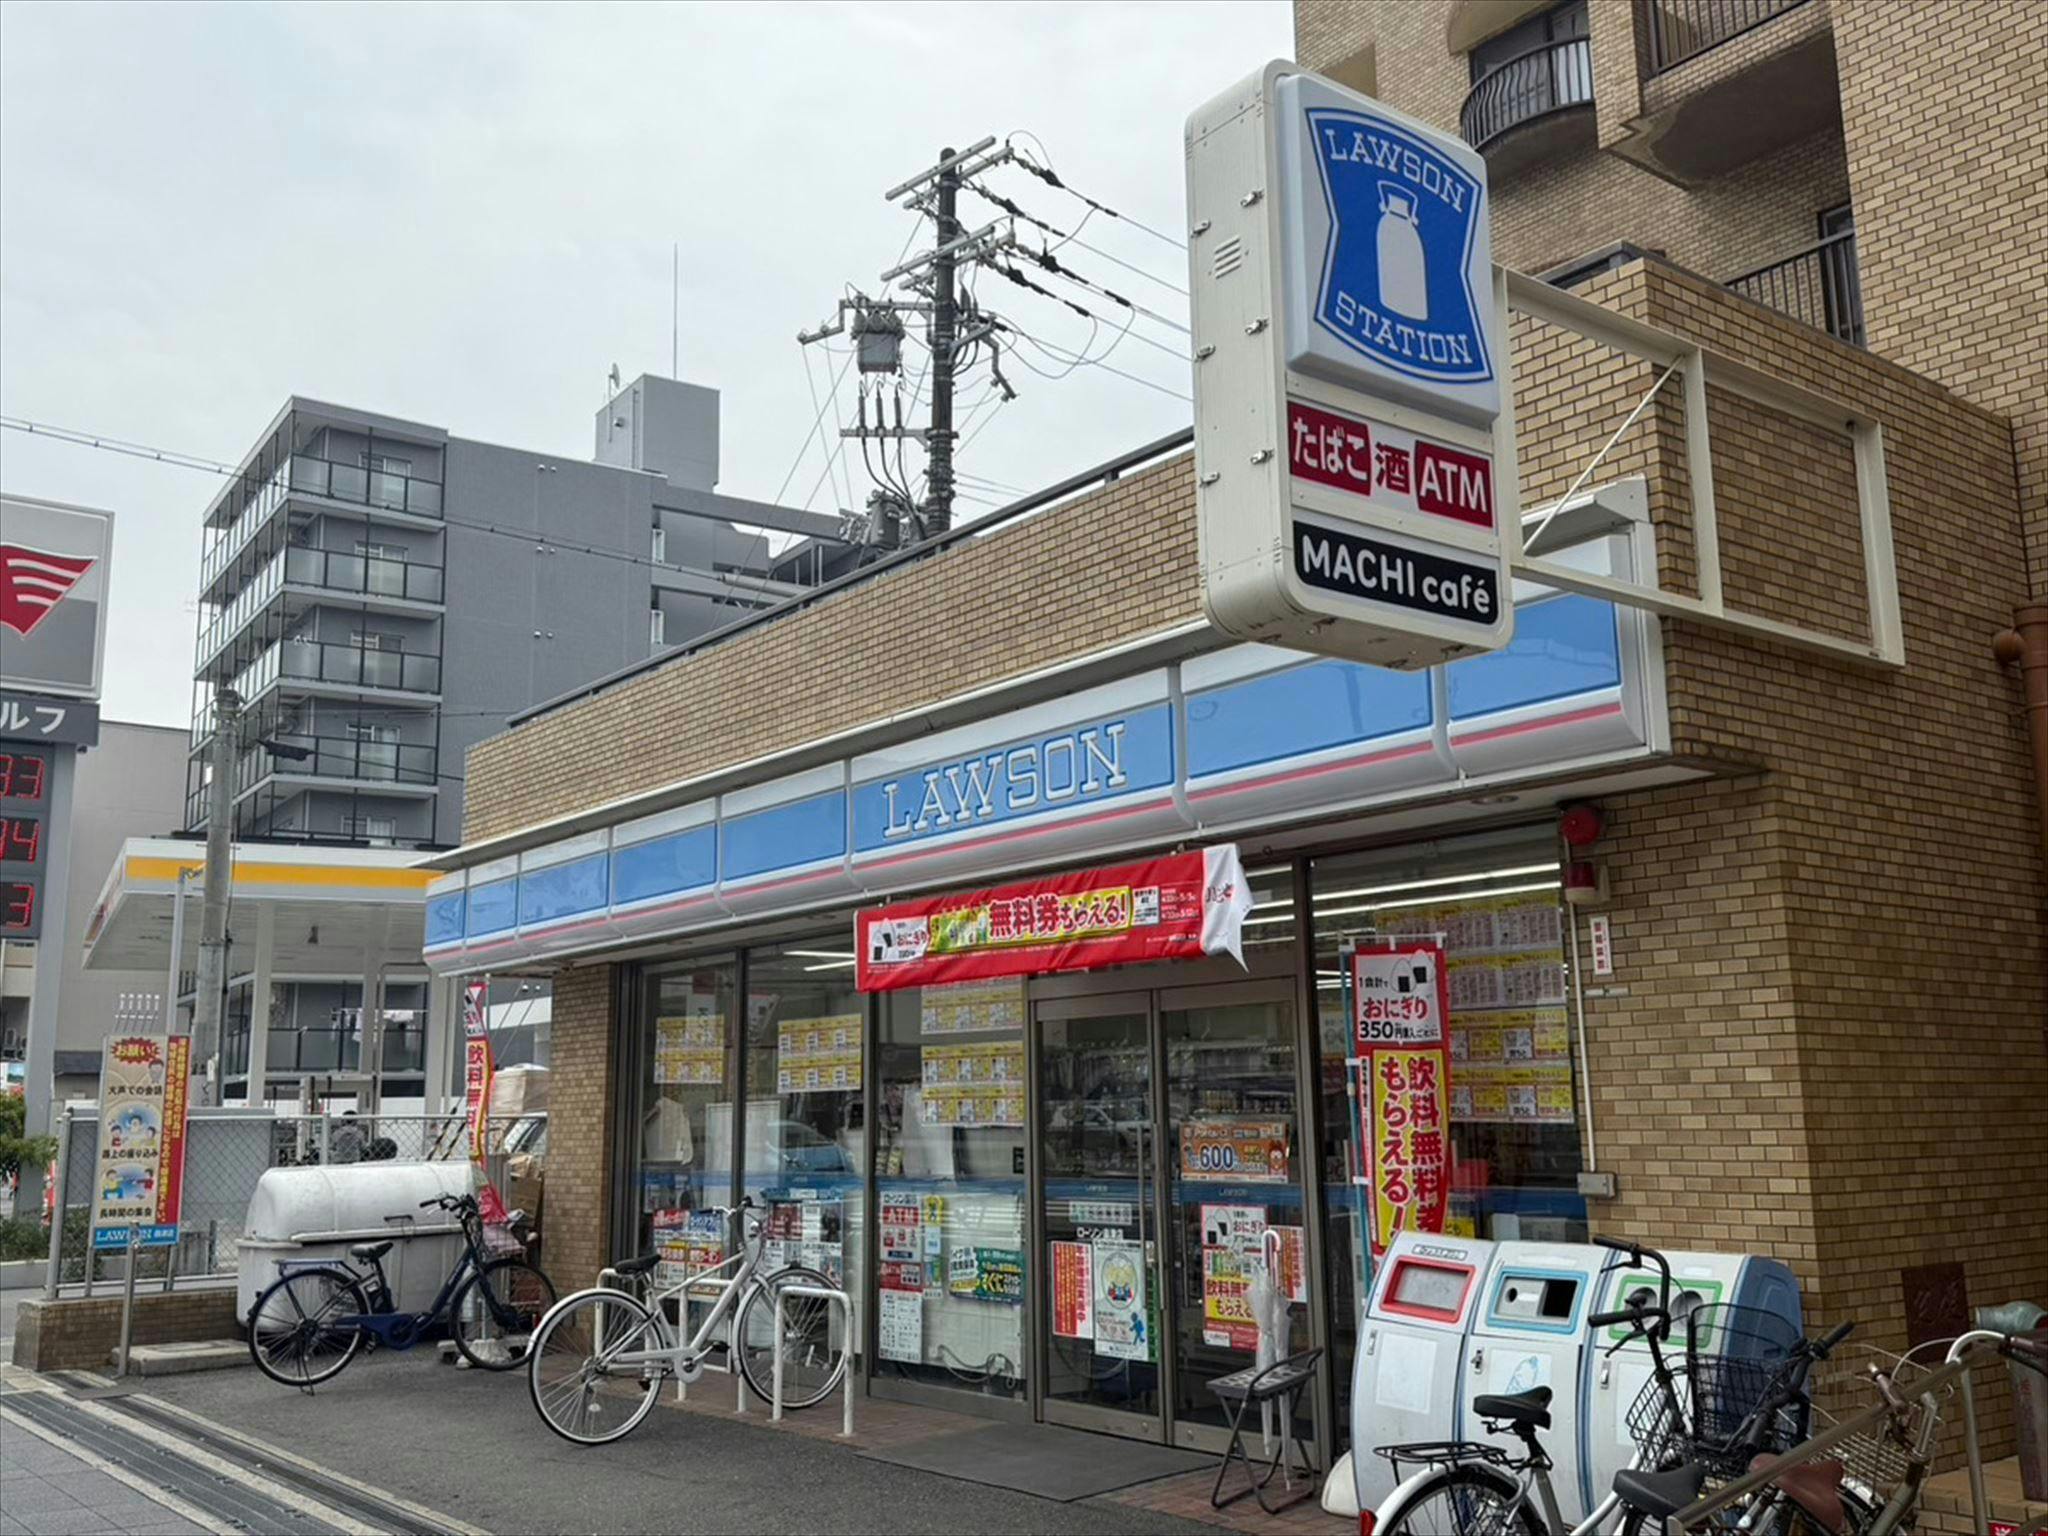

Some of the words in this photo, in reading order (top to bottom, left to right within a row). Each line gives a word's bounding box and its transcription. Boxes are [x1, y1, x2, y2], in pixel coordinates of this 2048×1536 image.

[1325, 127, 1466, 214] LAWSON
[1335, 290, 1473, 364] STATION
[1292, 415, 1370, 482] たばこ
[1374, 443, 1411, 495] 酒
[1418, 459, 1488, 513] ATM
[1301, 535, 1415, 597] MACHI
[1422, 574, 1490, 615] café
[882, 722, 1127, 839] LAWSON
[988, 890, 1128, 941] 無料券もらえる!
[1363, 996, 1428, 1019] おにぎり
[1200, 1142, 1234, 1171] 600
[96, 1228, 152, 1241] LAWN
